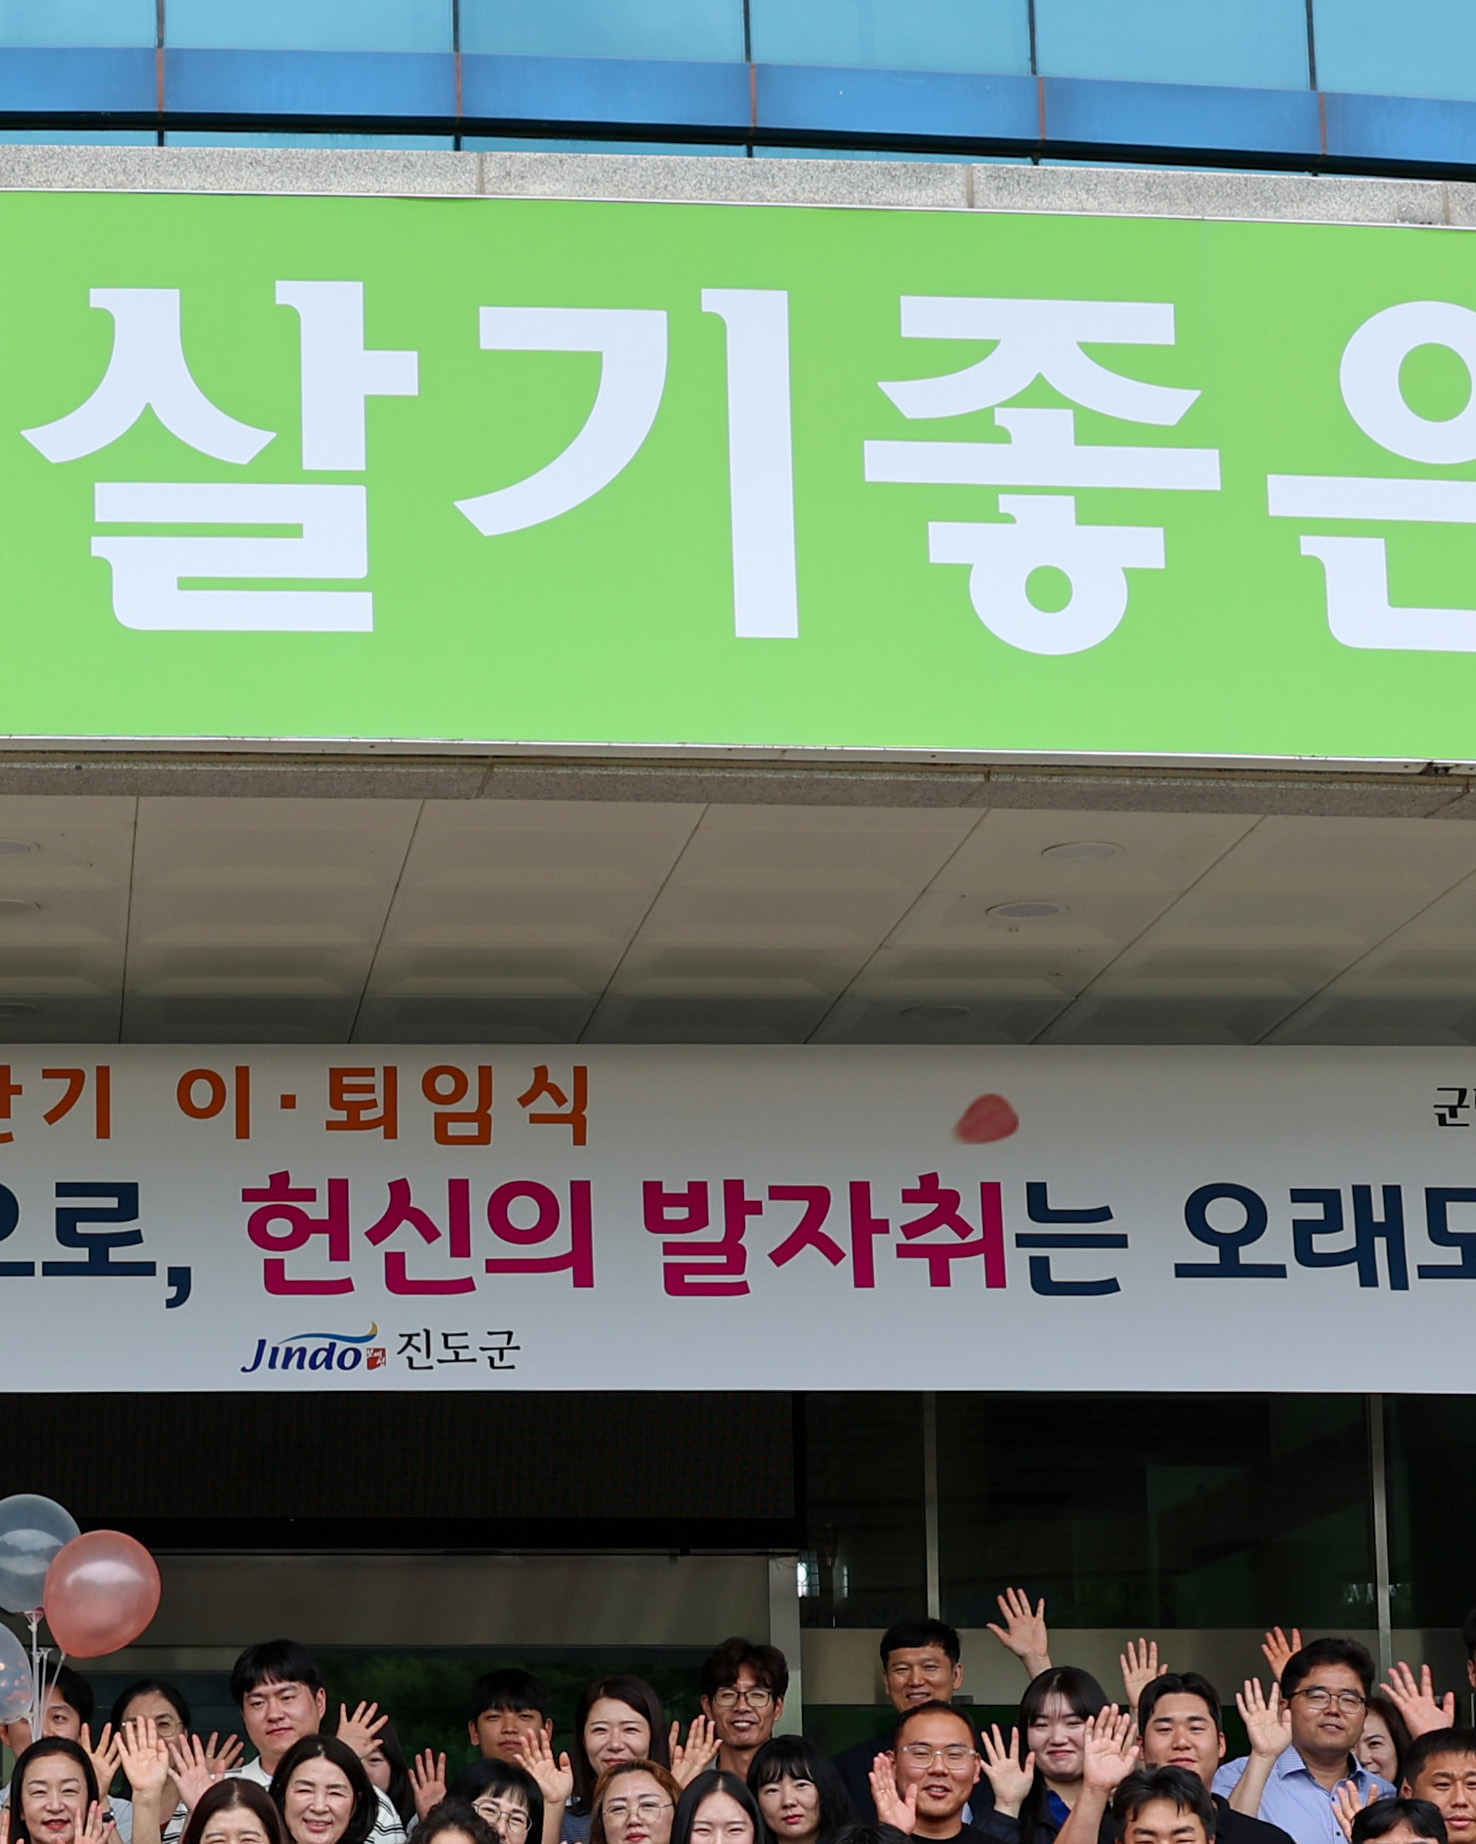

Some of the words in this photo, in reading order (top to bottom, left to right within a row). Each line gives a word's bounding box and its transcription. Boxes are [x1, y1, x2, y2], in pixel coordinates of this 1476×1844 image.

[242, 1170, 594, 1295] 헌신의
[643, 1172, 1128, 1296] 발자취는
[241, 1337, 363, 1373] Jindo
[398, 1328, 521, 1371] 진도군
